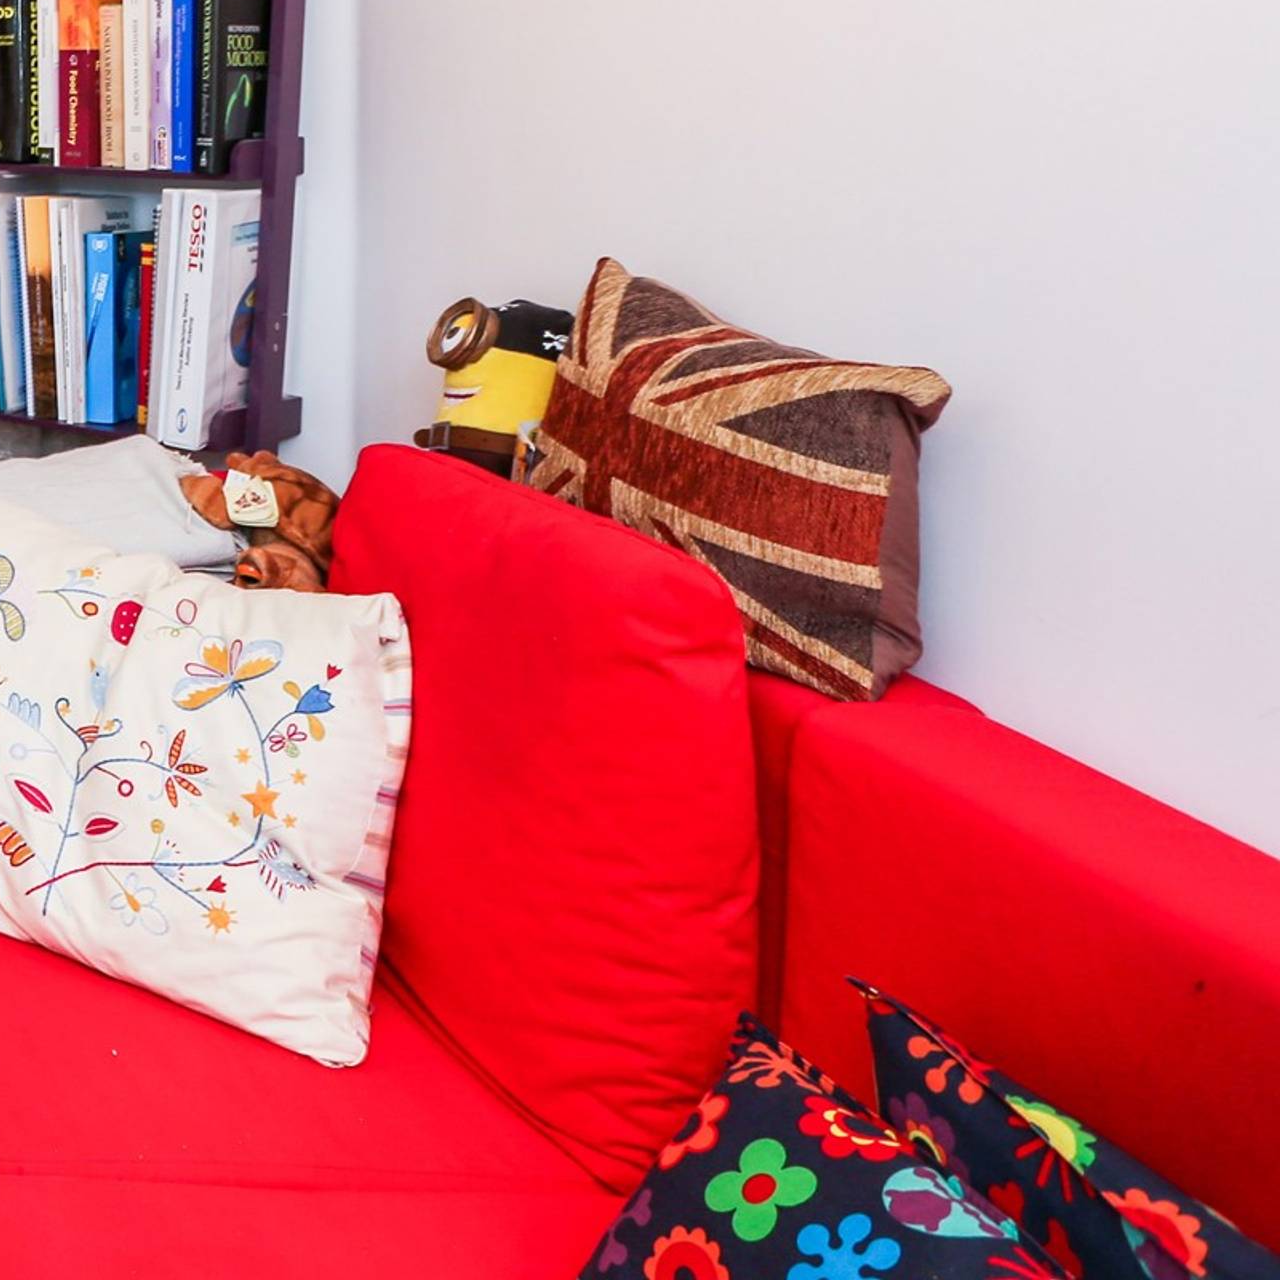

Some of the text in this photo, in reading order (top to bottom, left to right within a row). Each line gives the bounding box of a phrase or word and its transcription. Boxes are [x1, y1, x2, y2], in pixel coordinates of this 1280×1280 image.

[103, 26, 112, 92] PRESERVATION
[201, 15, 212, 81] MICROBIOLOGY
[227, 34, 254, 51] FOOD
[68, 70, 79, 95] Food
[67, 96, 79, 146] Chemistry
[187, 204, 202, 271] TESCO
